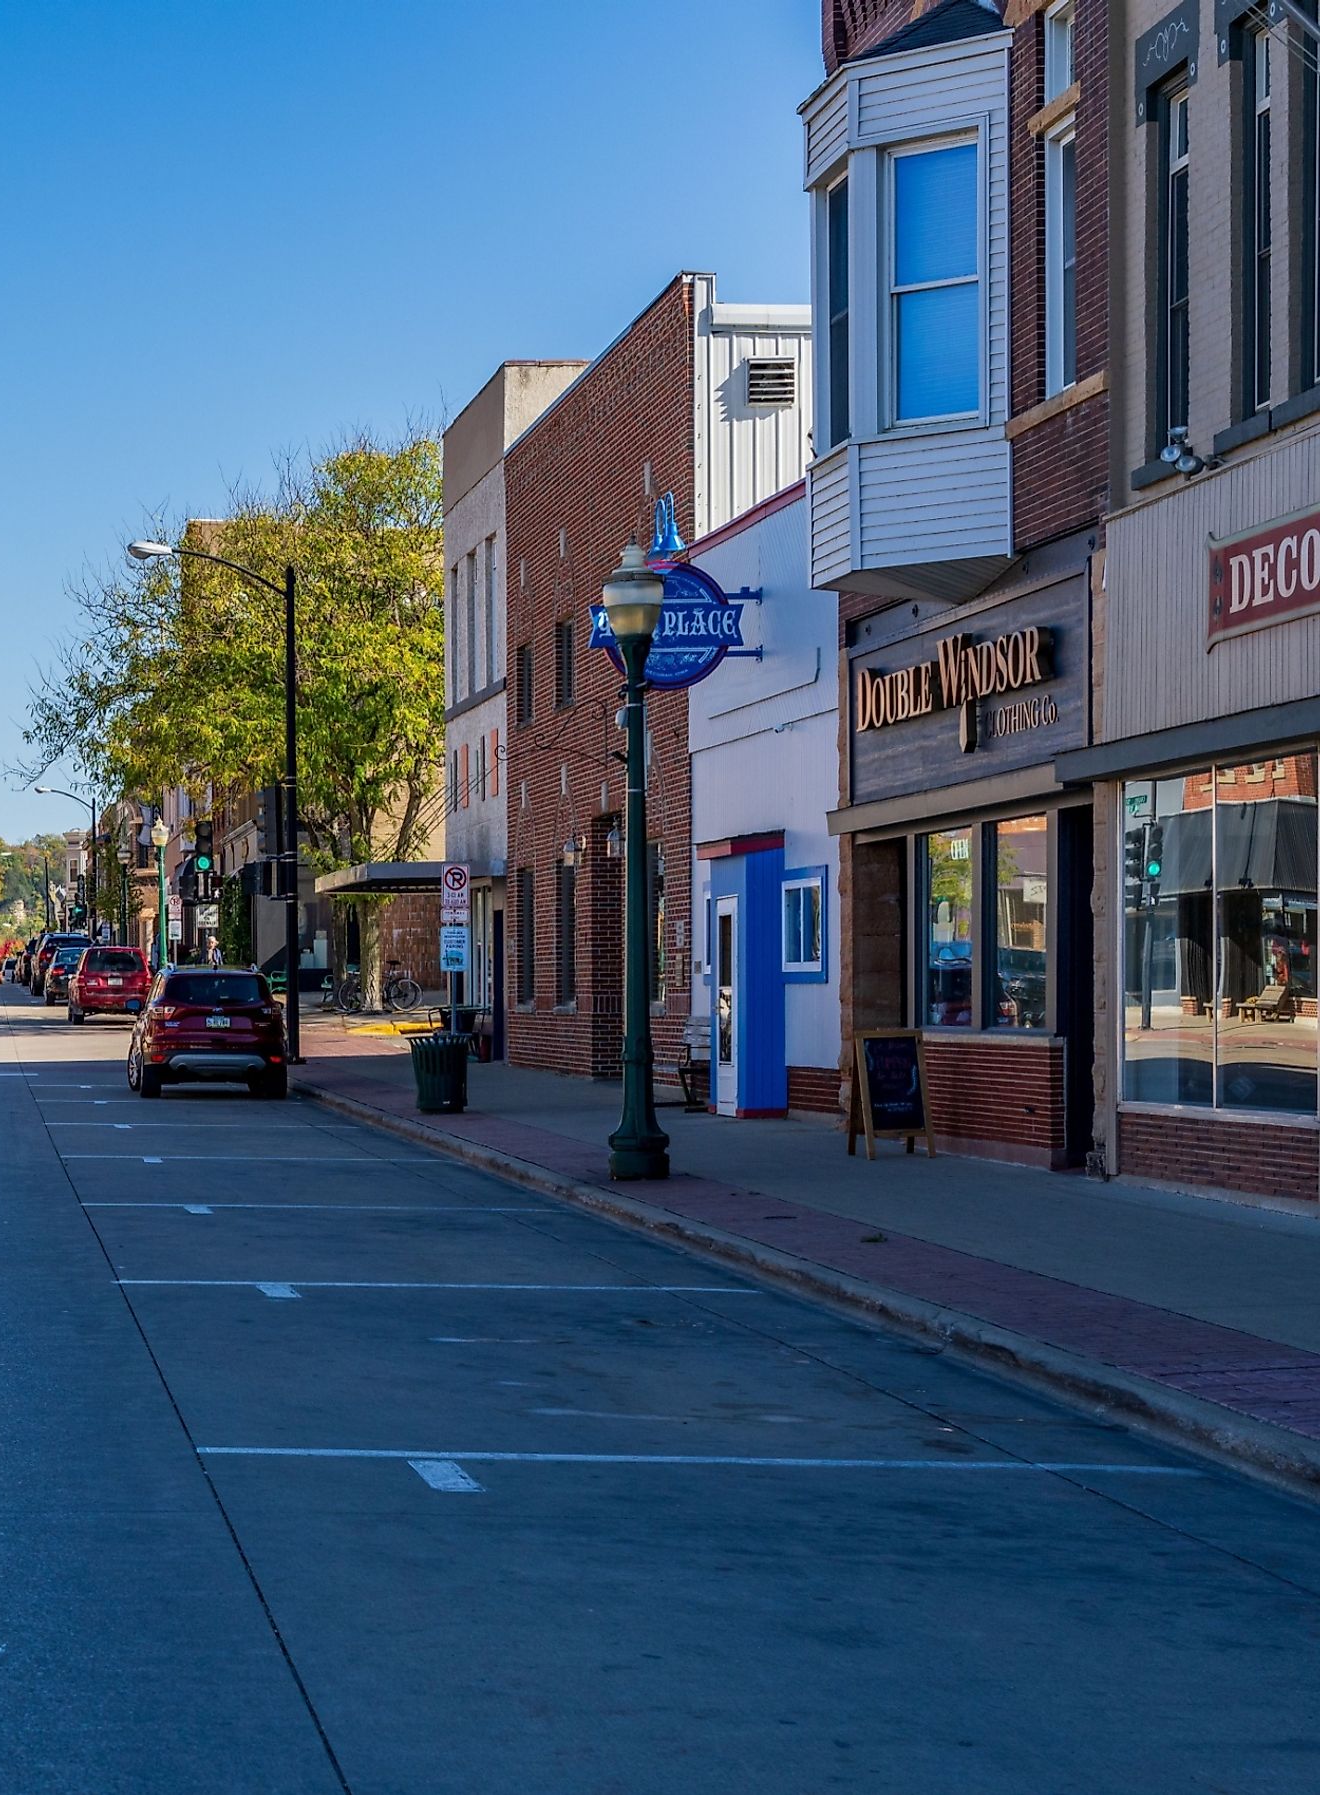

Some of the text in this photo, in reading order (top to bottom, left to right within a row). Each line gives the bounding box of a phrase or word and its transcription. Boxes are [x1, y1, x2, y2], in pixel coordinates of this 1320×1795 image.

[1229, 528, 1320, 614] DECO
[662, 608, 738, 638] PLACE
[856, 662, 933, 732] DOUBLE
[985, 698, 1040, 739] CLOTHING
[951, 839, 969, 860] OPEN
